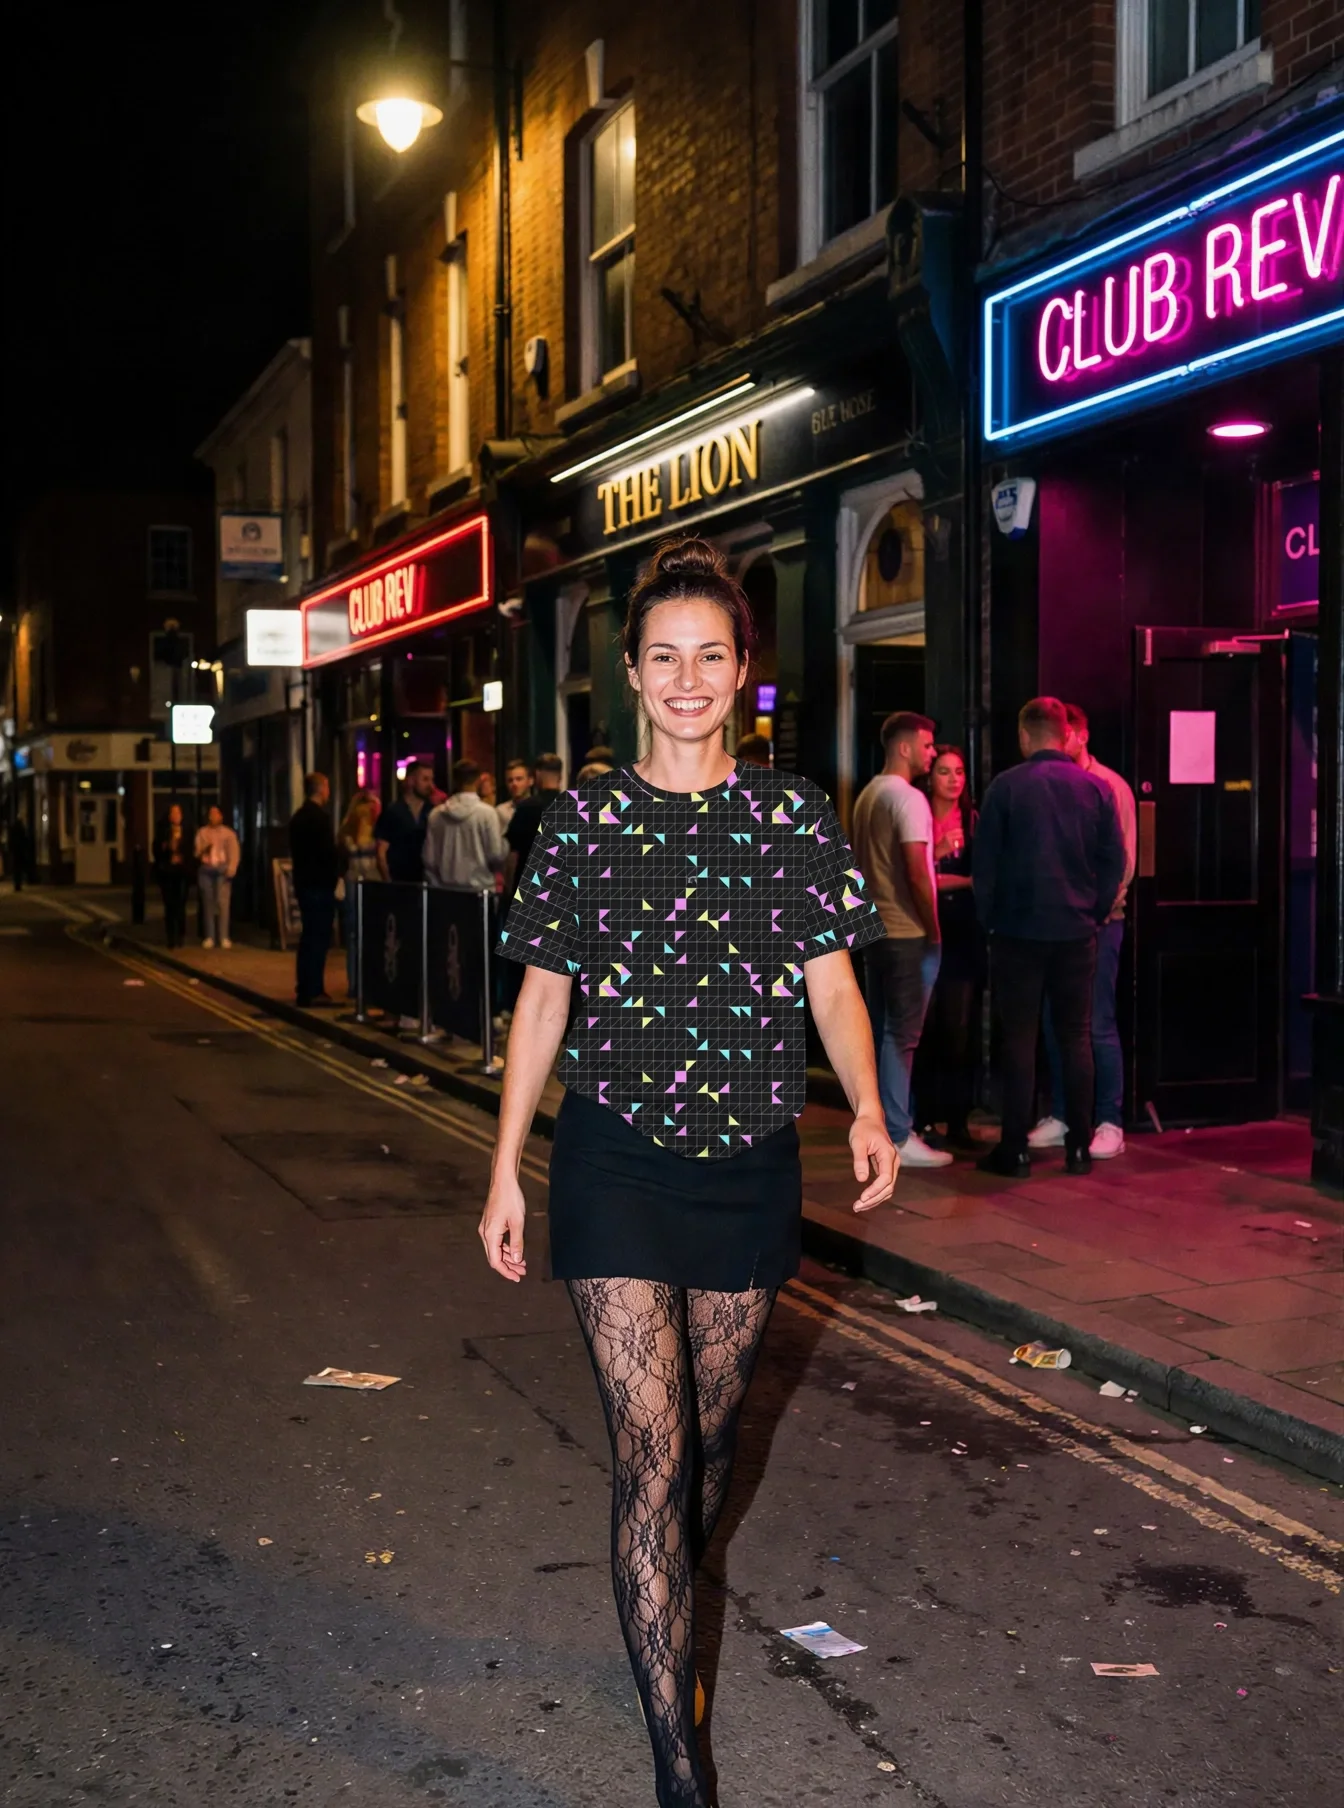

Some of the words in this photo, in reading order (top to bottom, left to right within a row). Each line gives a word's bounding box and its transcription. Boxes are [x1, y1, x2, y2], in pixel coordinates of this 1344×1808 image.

[1038, 251, 1178, 382] CLUB
[1205, 174, 1341, 319] REV
[597, 463, 663, 535] THE
[668, 418, 762, 511] LION
[348, 578, 385, 635] CLUB
[385, 563, 415, 621] REV
